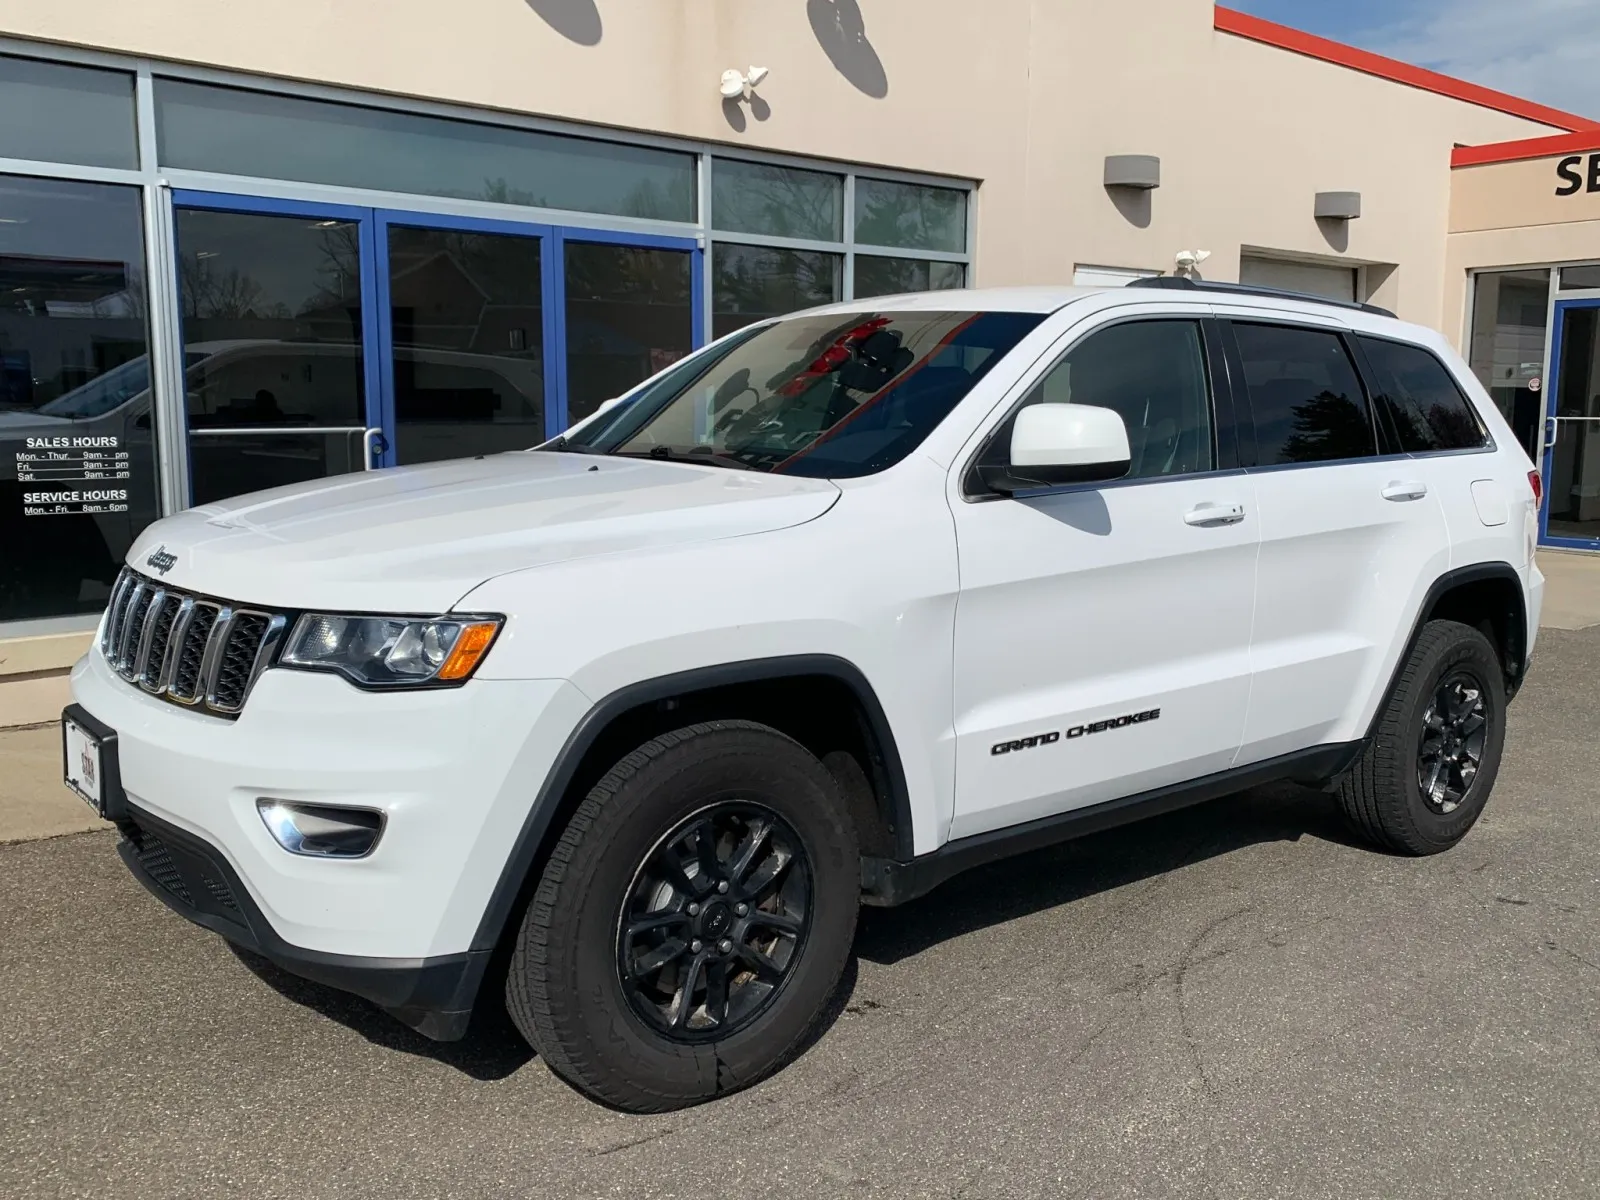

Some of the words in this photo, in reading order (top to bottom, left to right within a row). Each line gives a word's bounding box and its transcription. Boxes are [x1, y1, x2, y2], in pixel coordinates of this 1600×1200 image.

[1555, 152, 1600, 196] SE
[26, 437, 70, 447] SALES
[73, 436, 118, 447] HOURS
[16, 452, 39, 461] Mon.
[47, 451, 70, 460] Thur.
[83, 451, 102, 459] 9am
[115, 451, 129, 459] pm
[17, 462, 32, 470] Fri.
[83, 461, 102, 469] 9am
[115, 461, 129, 469] pm
[18, 472, 36, 480] Sat.
[84, 470, 104, 478] 9am
[116, 471, 130, 479] pm
[23, 491, 80, 503] SERVICE
[83, 490, 127, 500] HOURS
[24, 506, 47, 515] Mon.
[55, 505, 69, 513] Fri.
[82, 504, 102, 512] 8am
[109, 503, 128, 512] 6pm
[147, 544, 178, 576] Jeep
[991, 731, 1060, 756] GRAND
[1066, 708, 1161, 740] CHEROKEE
